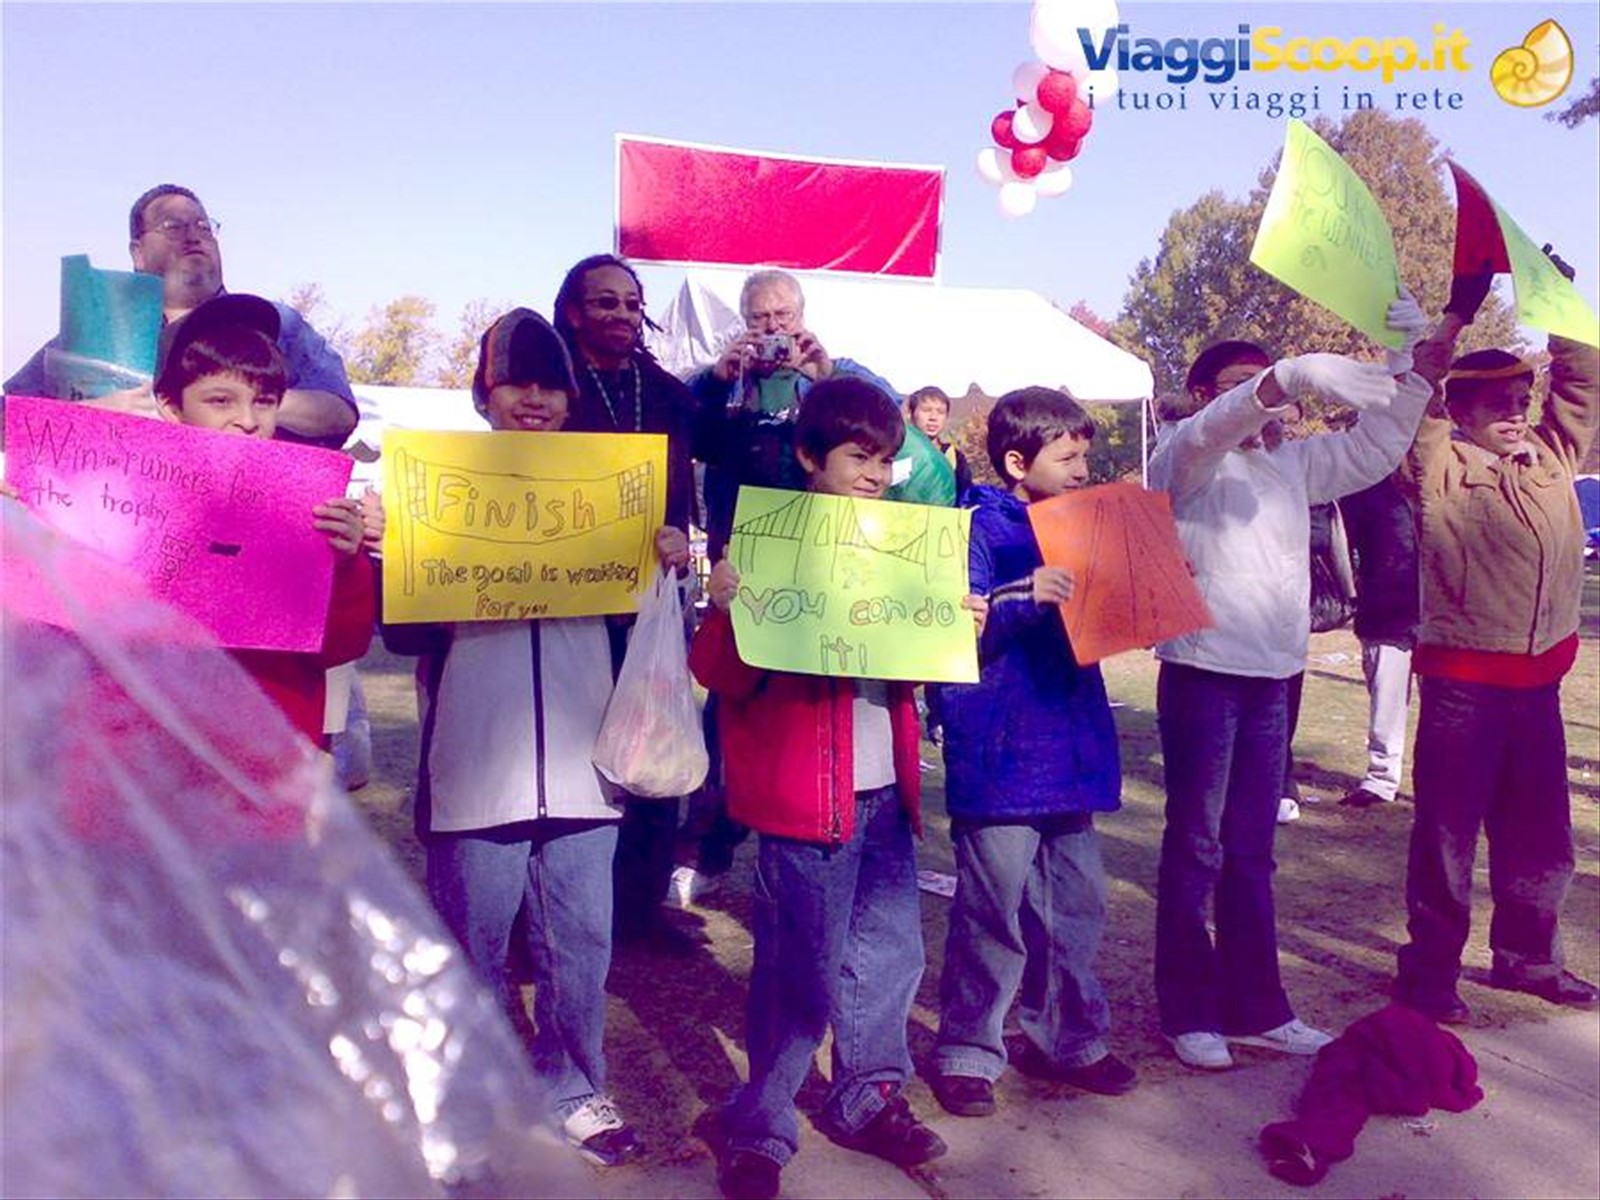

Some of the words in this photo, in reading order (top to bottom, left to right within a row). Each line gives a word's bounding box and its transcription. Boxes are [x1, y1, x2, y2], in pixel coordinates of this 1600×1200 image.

[24, 412, 98, 472] Win
[31, 478, 73, 506] the
[101, 482, 169, 528] trophy
[435, 473, 596, 537] Finish
[421, 558, 468, 587] The
[472, 561, 532, 592] goal
[541, 564, 558, 582] is
[912, 596, 956, 628] do
